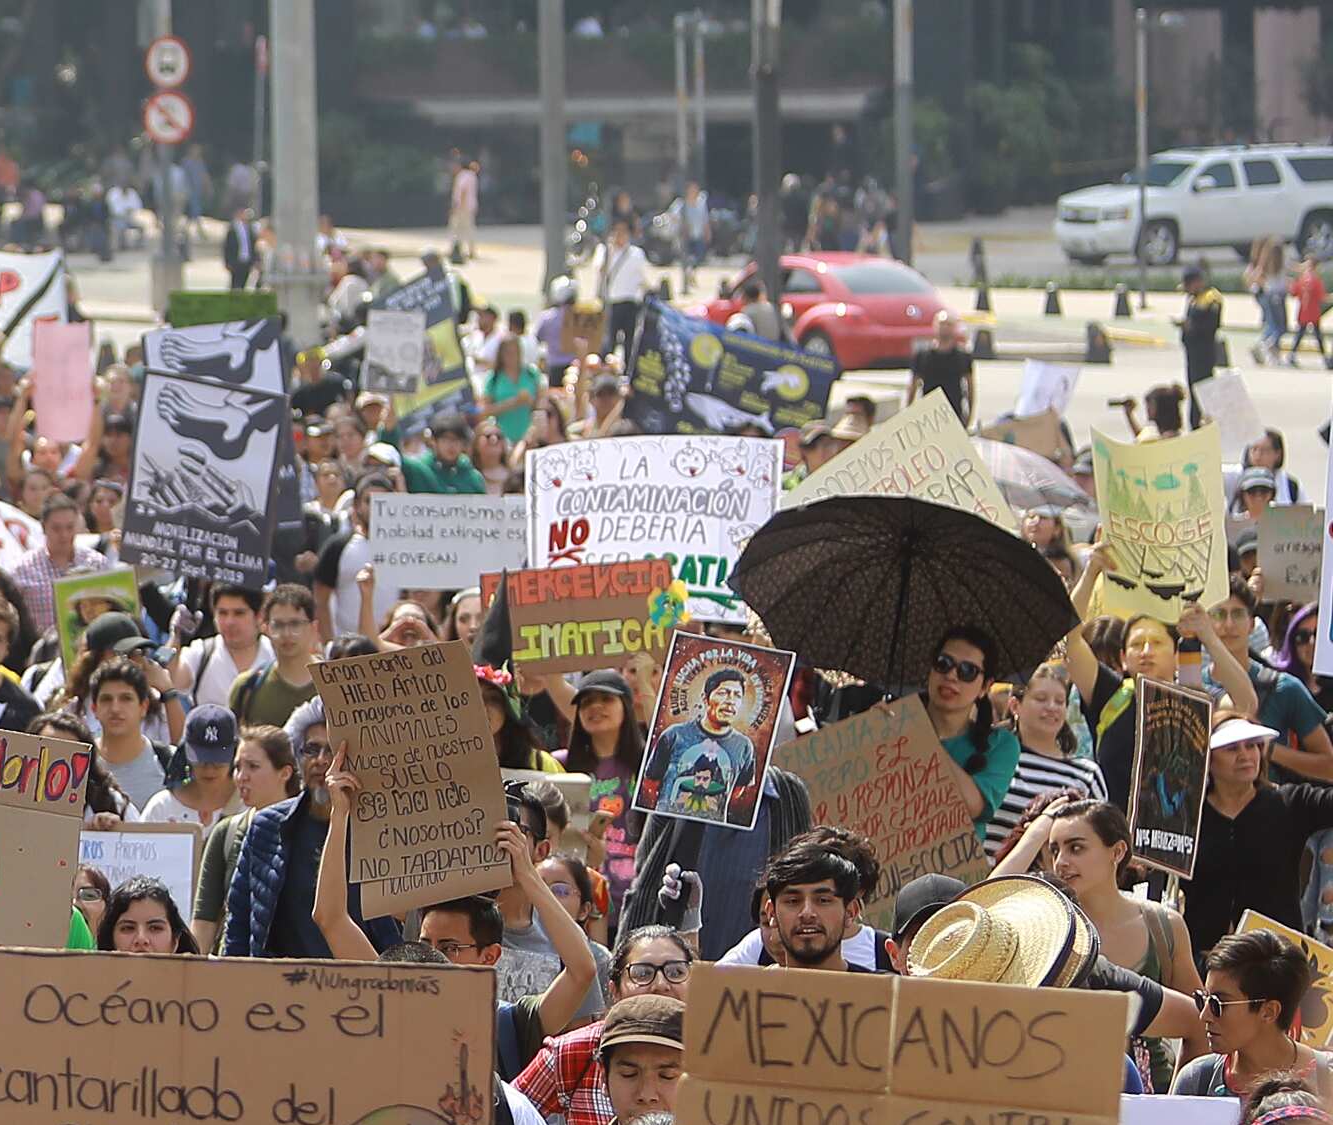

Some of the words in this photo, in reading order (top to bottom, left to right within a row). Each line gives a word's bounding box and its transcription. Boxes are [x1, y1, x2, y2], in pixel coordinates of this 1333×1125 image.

[619, 455, 649, 480] LA
[556, 481, 751, 521] CONTAMINACIÓN
[549, 517, 590, 550] NO
[597, 515, 707, 544] DEBERÍA
[1108, 509, 1214, 545] ESCOGE
[512, 619, 666, 661] IMATICA
[319, 662, 367, 685] Gran
[359, 714, 459, 750] ANIMALES
[380, 761, 453, 791] SUELO
[359, 857, 391, 881] NO
[245, 1000, 307, 1033] es
[332, 993, 385, 1038] el
[699, 986, 1069, 1081] MEXICANOS
